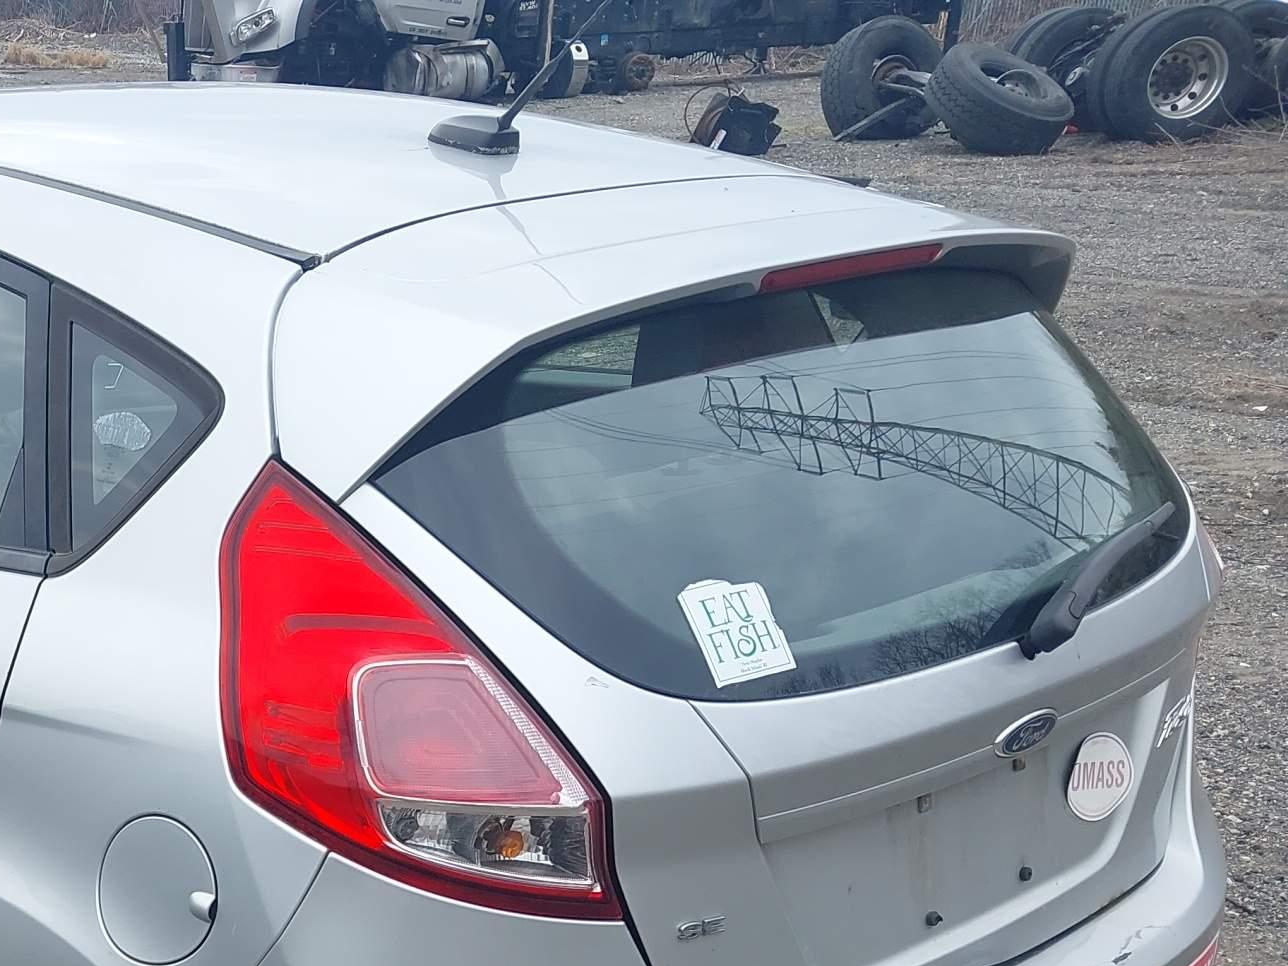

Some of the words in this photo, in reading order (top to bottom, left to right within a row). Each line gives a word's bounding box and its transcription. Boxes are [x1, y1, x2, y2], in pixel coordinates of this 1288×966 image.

[698, 589, 754, 628] EAT
[707, 620, 780, 664] FISH
[1013, 717, 1050, 751] Ford
[1072, 760, 1125, 791] UMASS
[677, 915, 726, 940] SE
